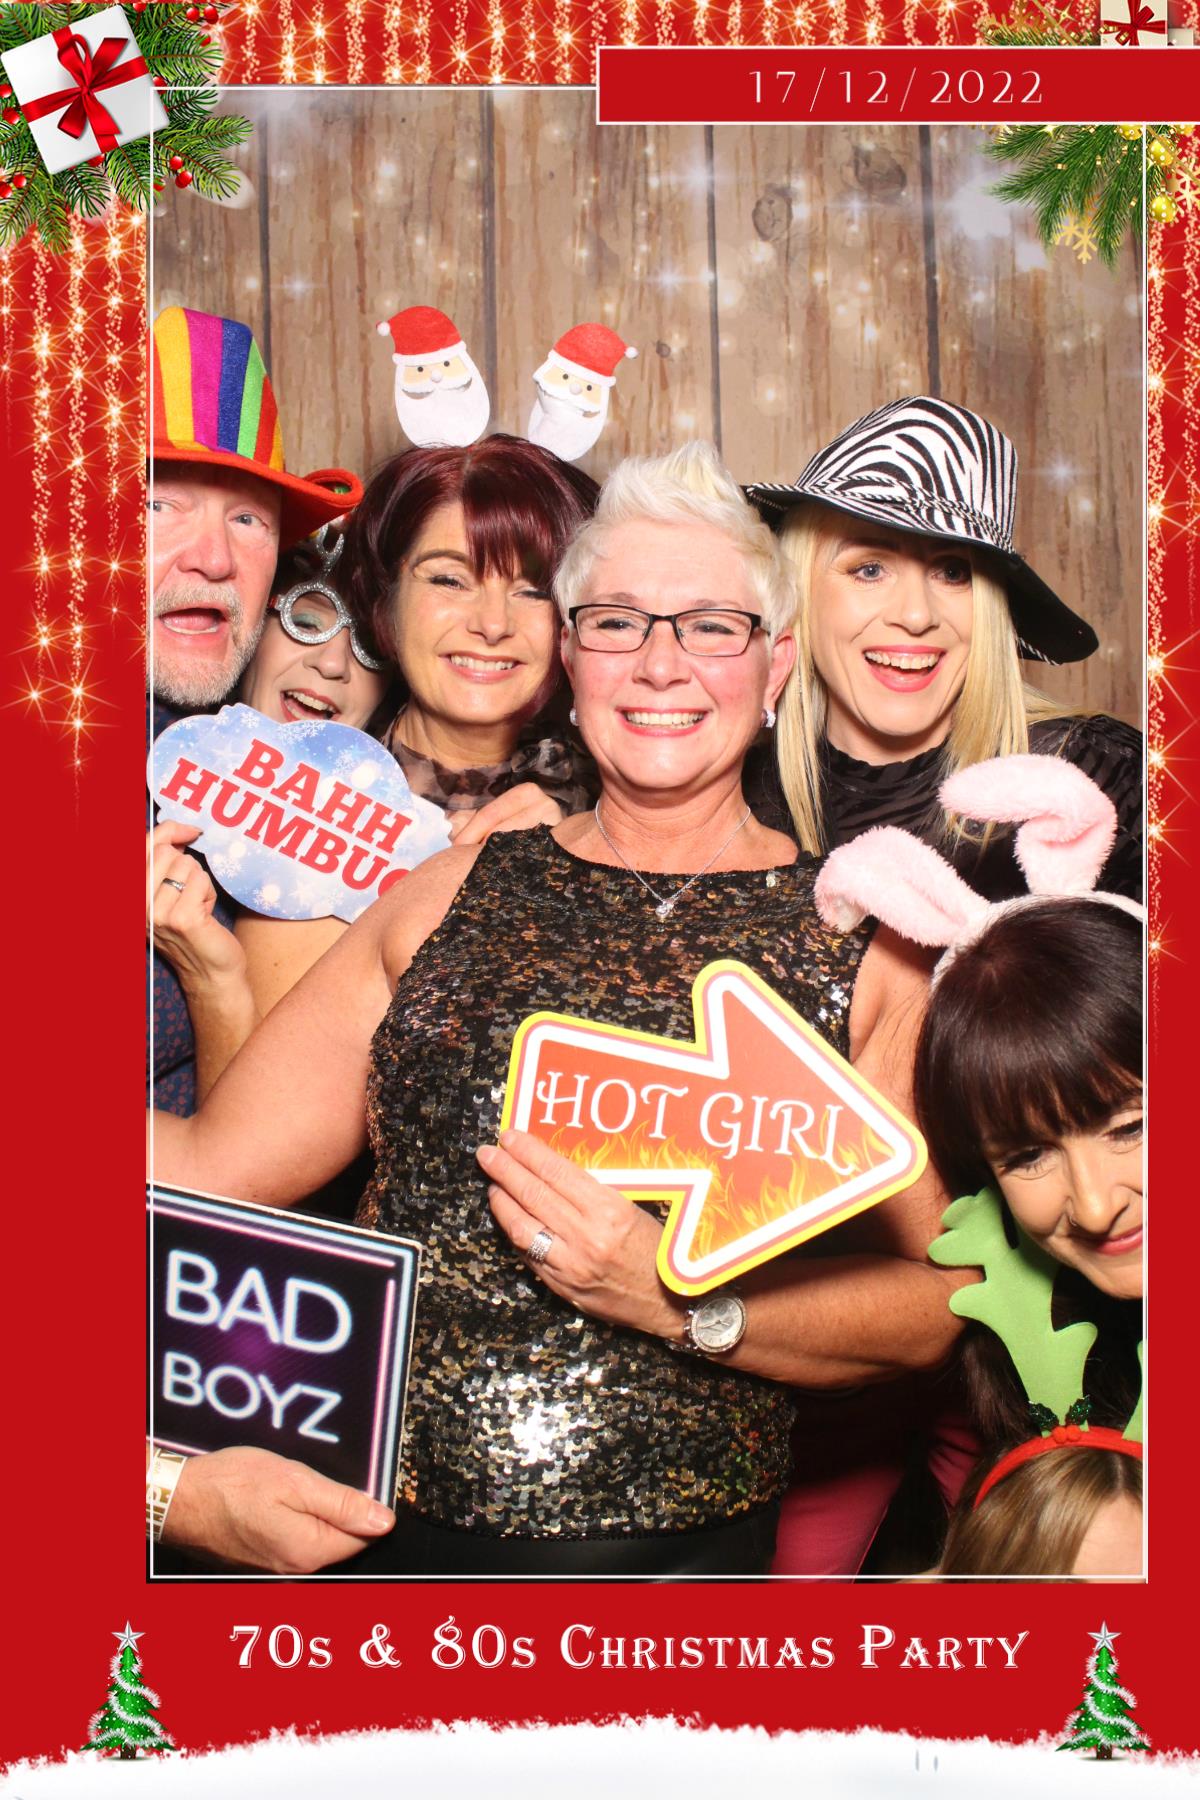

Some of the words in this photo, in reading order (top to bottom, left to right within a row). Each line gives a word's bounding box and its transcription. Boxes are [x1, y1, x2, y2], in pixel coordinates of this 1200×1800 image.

[232, 738, 412, 854] BAHH
[536, 1071, 688, 1139] HOT
[700, 1091, 855, 1176] GIRL
[166, 1249, 352, 1354] BAD
[163, 1351, 342, 1443] BOYZ
